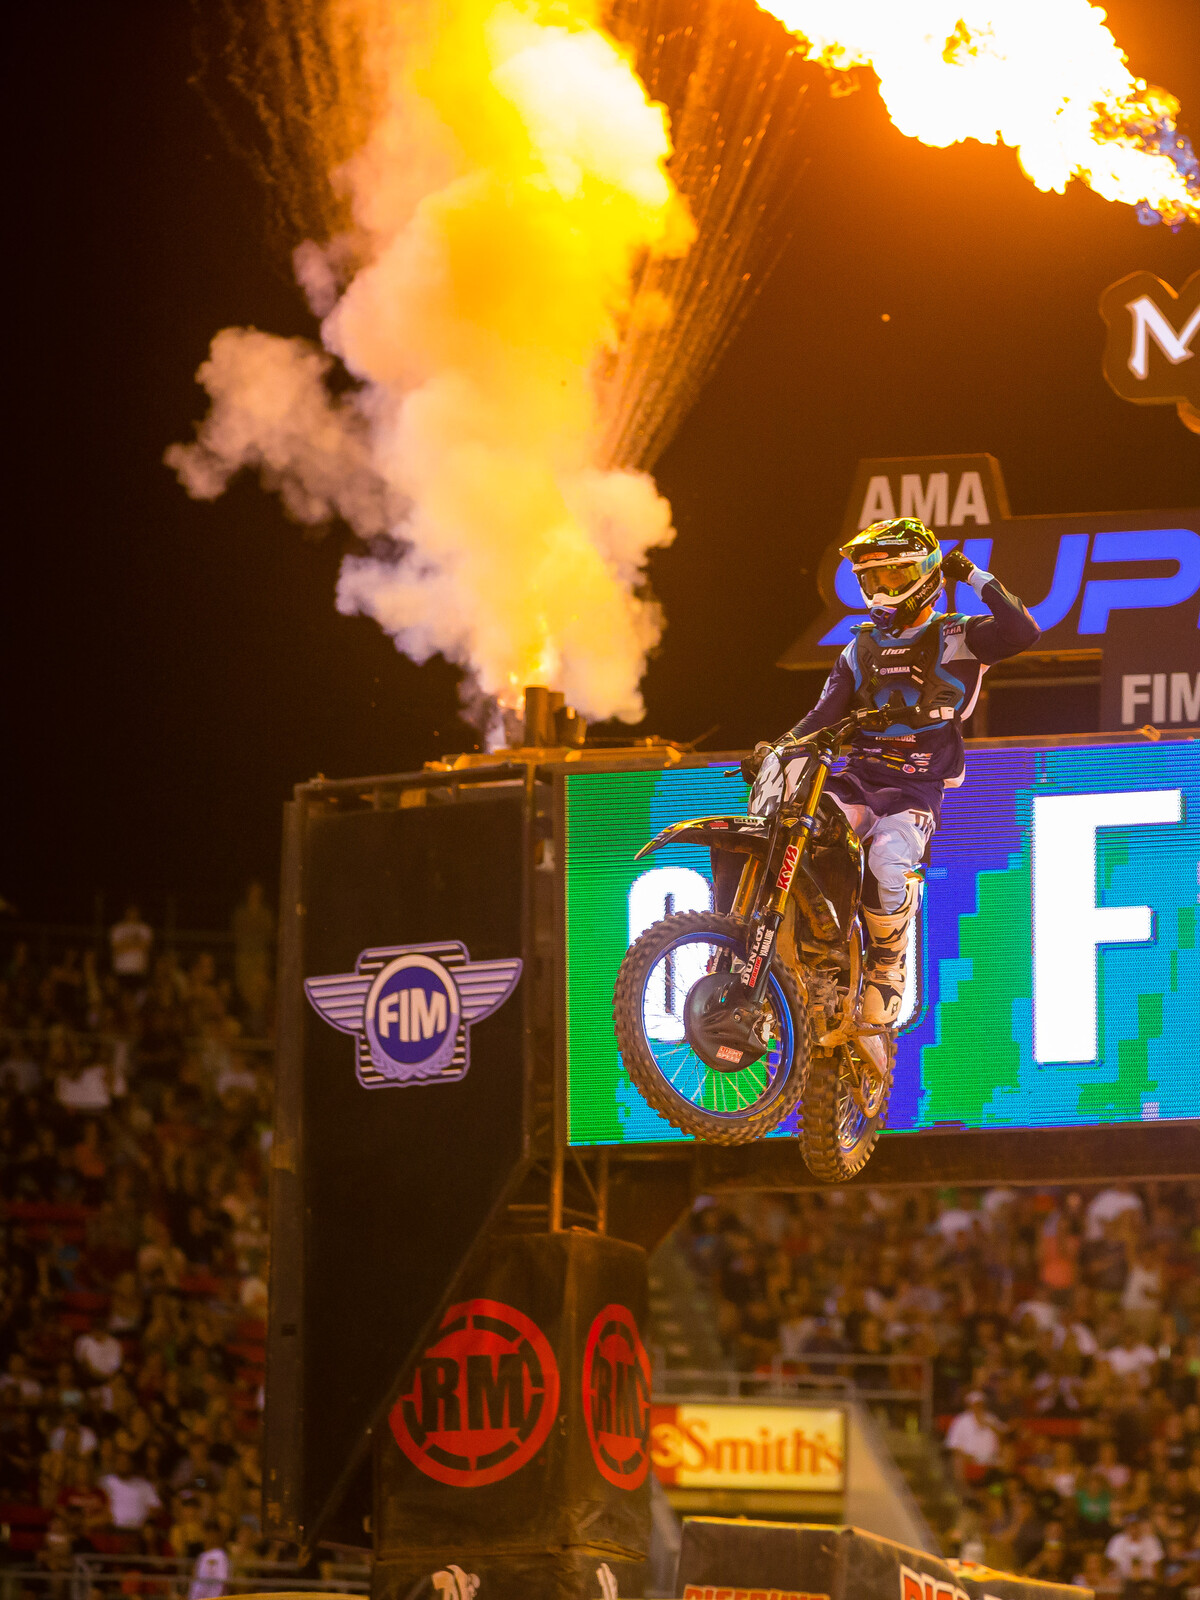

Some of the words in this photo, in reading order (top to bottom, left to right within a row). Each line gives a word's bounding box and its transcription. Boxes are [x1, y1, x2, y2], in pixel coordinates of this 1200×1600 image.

[859, 471, 991, 529] AMA
[881, 647, 911, 656] thor
[886, 666, 911, 674] YAMAHA
[776, 844, 800, 892] KYB
[758, 928, 775, 957] YAMALUBE
[378, 987, 448, 1043] FIM
[681, 1418, 842, 1475] Smith's
